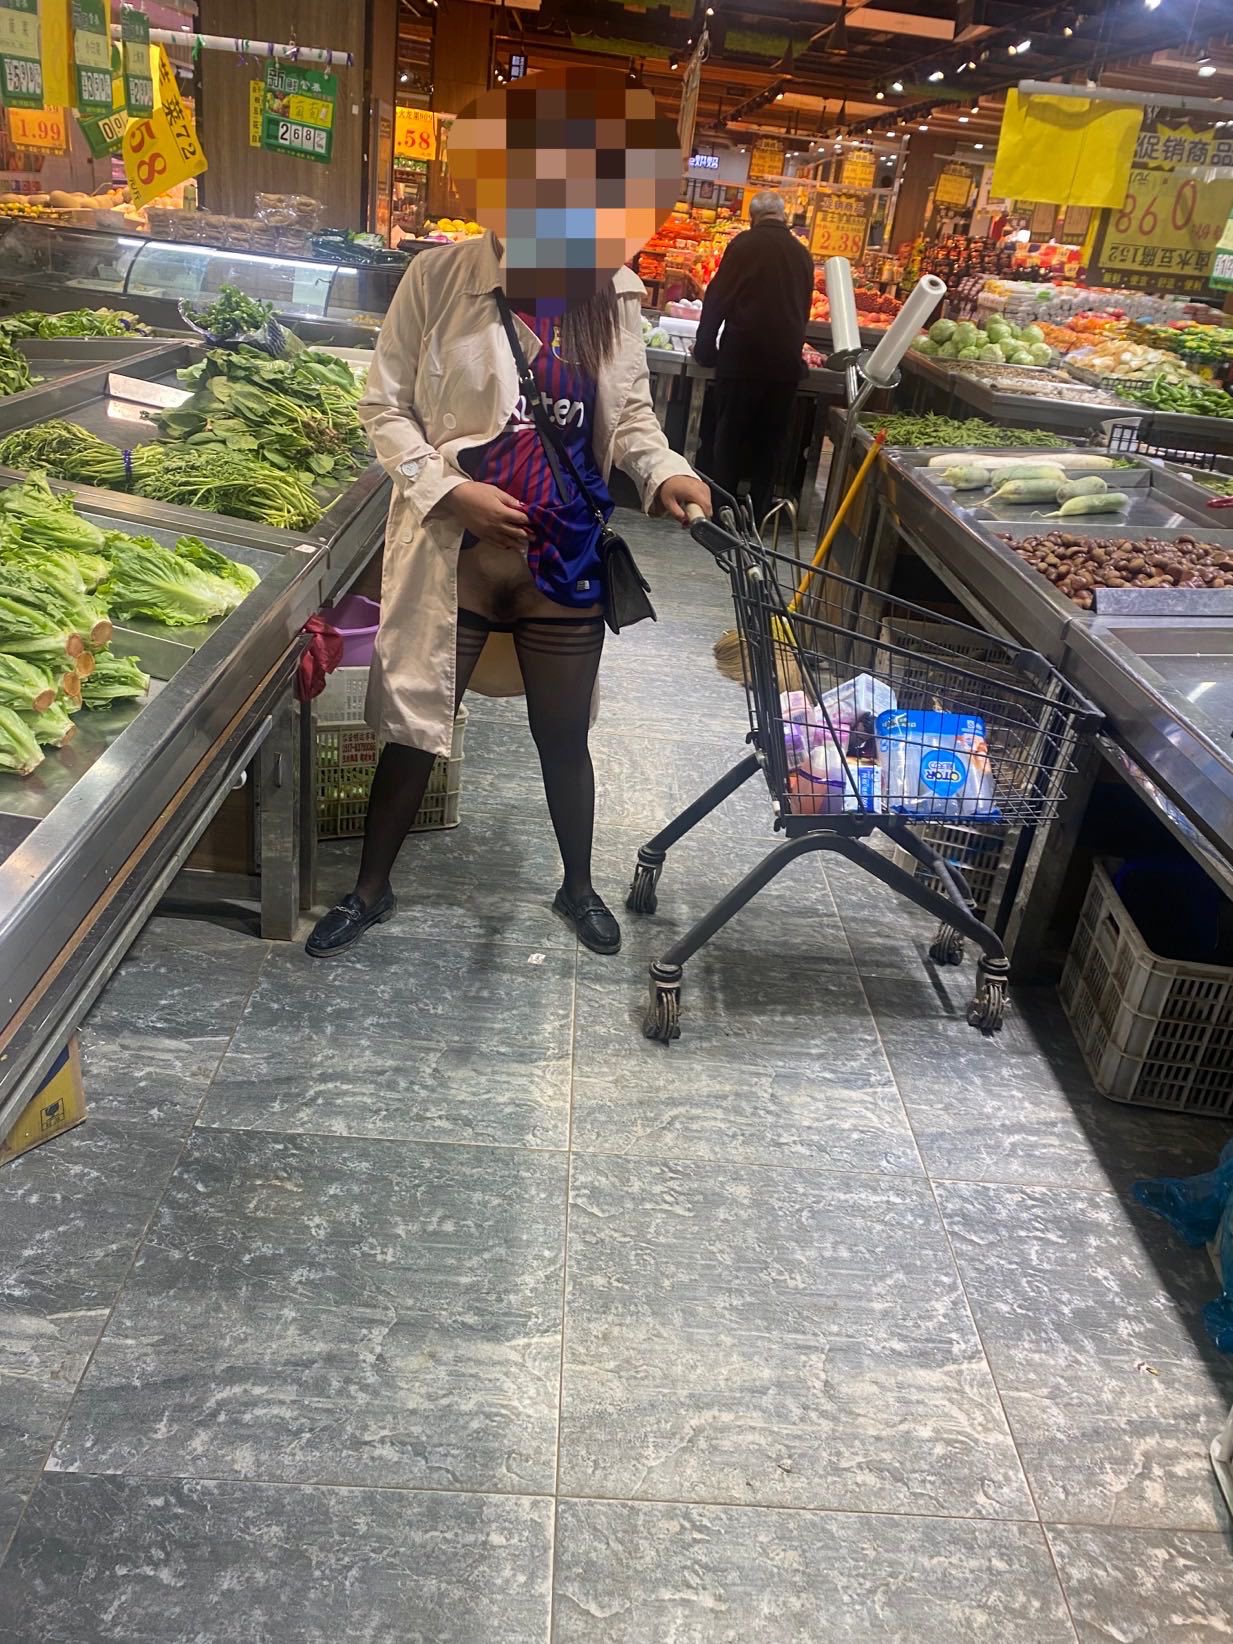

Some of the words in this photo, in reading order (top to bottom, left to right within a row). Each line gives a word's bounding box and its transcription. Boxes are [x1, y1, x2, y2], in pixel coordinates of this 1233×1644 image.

[20, 119, 61, 142] 1.99
[280, 123, 312, 142] 268
[129, 121, 168, 186] 58
[1136, 133, 1233, 167] 促销商品
[820, 231, 862, 254] 2.38
[1107, 244, 1213, 273] 卤水豆腐152
